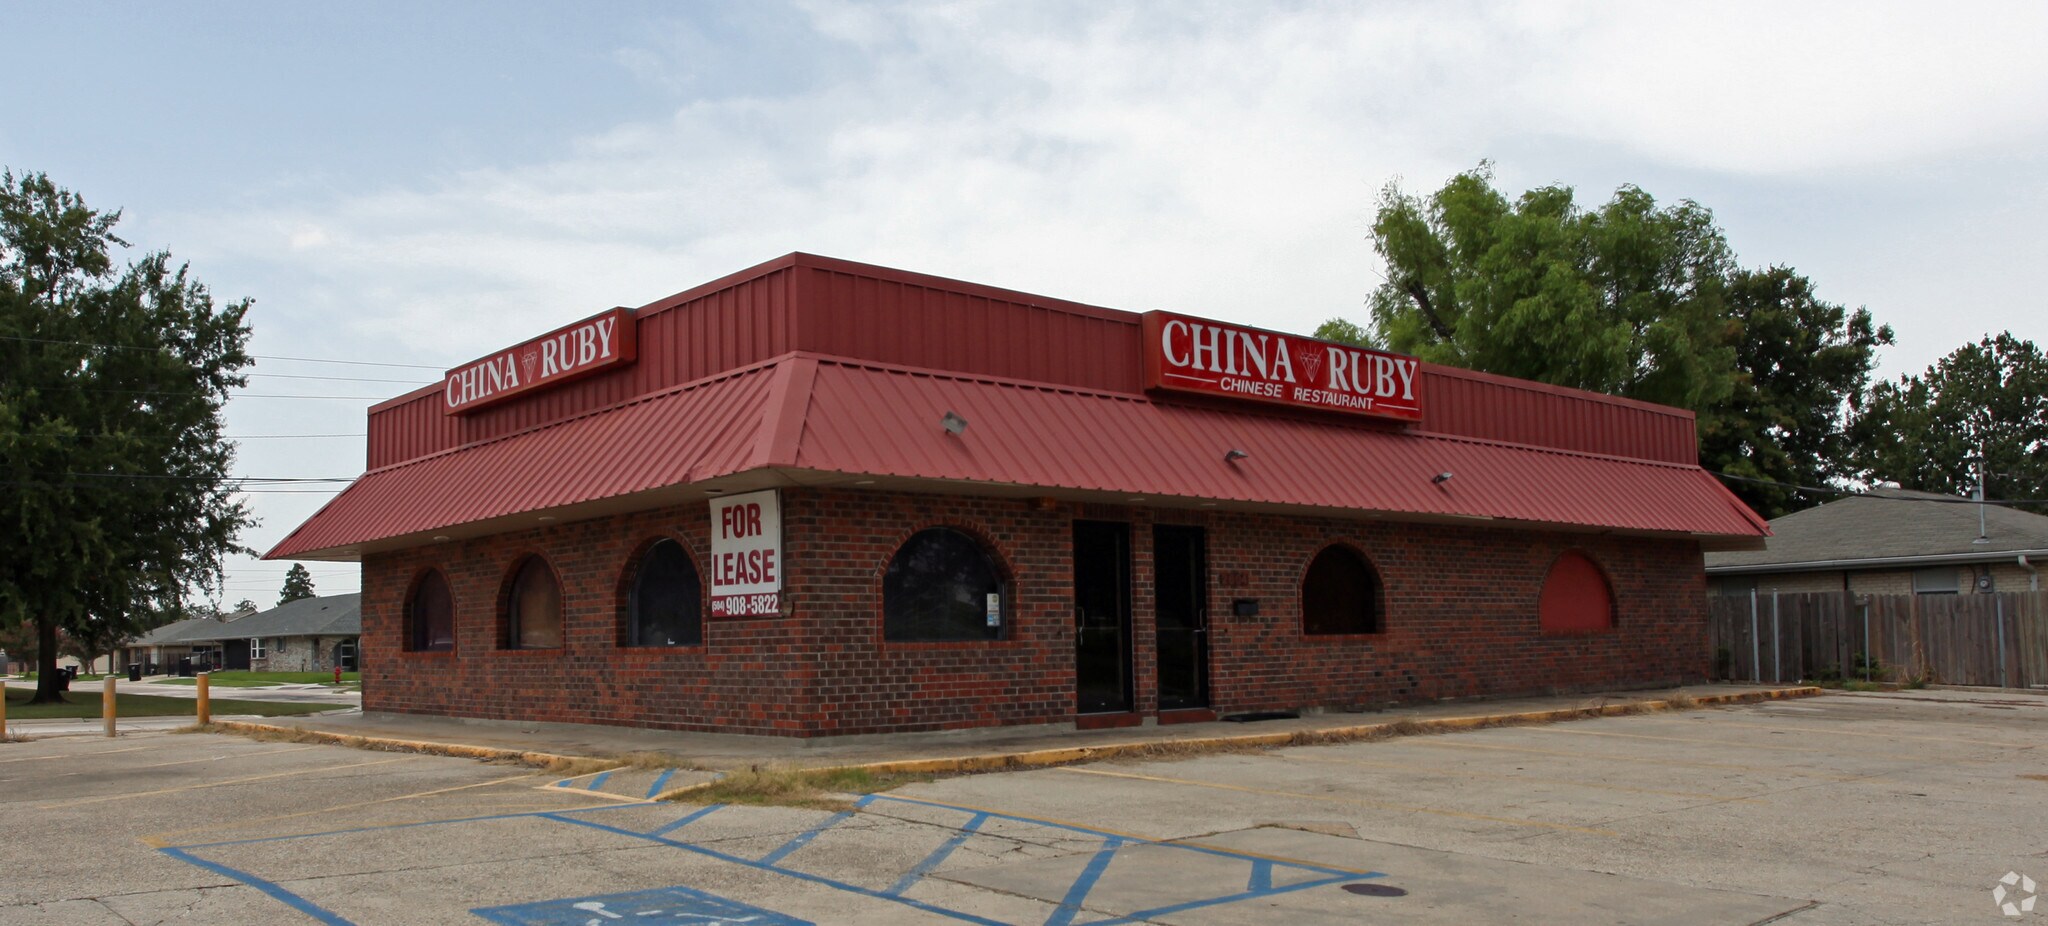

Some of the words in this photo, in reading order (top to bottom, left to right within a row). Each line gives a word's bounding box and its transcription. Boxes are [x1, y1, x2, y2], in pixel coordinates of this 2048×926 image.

[446, 352, 519, 408] CHINA
[540, 316, 615, 378] RUBY
[1162, 319, 1296, 383] CHINA
[1326, 346, 1418, 400] RUBY
[1220, 376, 1284, 398] CHINESE
[1293, 387, 1374, 410] RESTAURANT
[722, 503, 761, 539] FOR
[714, 549, 774, 586] LEASE
[726, 593, 778, 615] 908-5822
